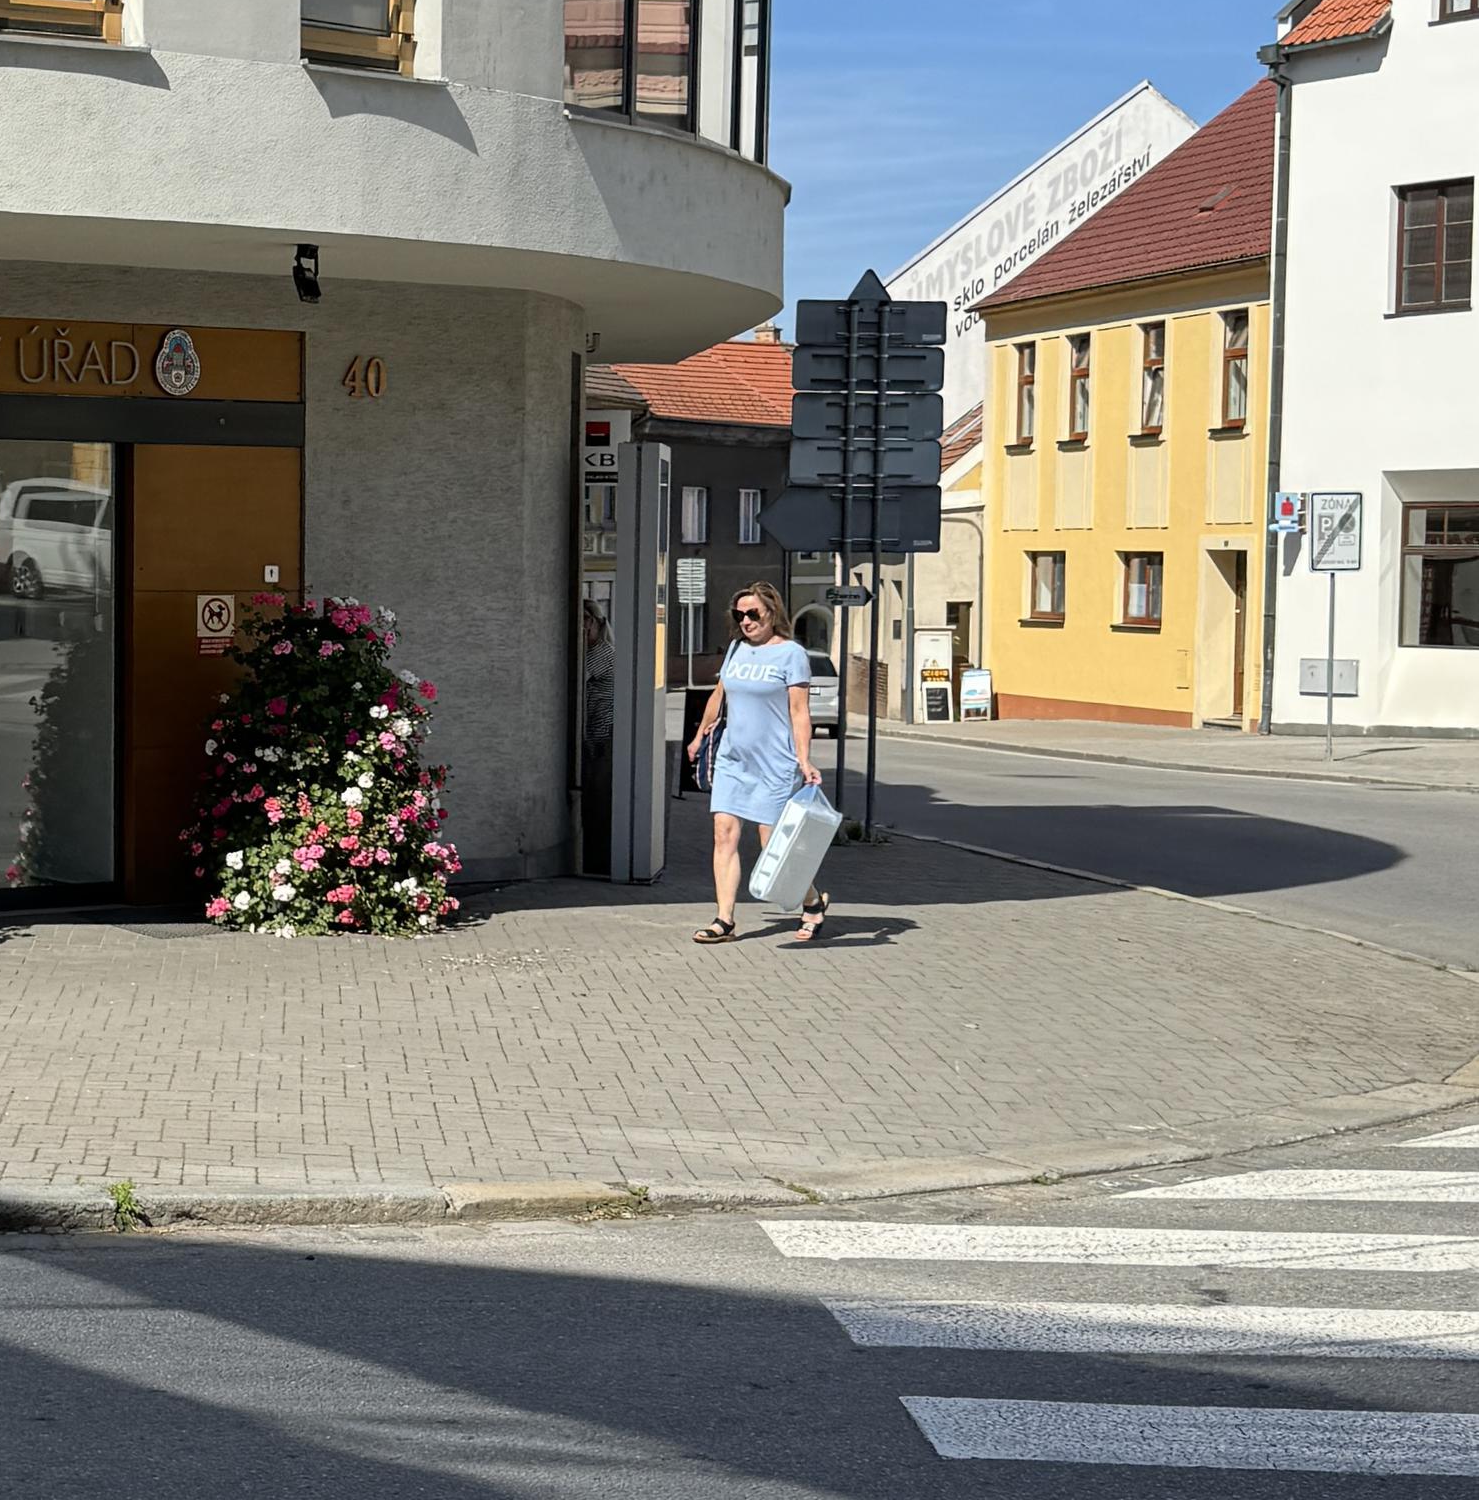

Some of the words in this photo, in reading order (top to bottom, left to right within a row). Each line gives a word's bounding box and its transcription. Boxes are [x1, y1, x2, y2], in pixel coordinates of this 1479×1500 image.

[1046, 115, 1125, 217] ZBOŽÍ
[953, 277, 984, 312] sklo
[994, 218, 1059, 287] porcelán
[1068, 144, 1152, 225] železářství
[19, 325, 141, 386] ÚŘAD
[342, 355, 387, 398] 40
[1322, 516, 1332, 535] P
[726, 662, 779, 683] OGUE
